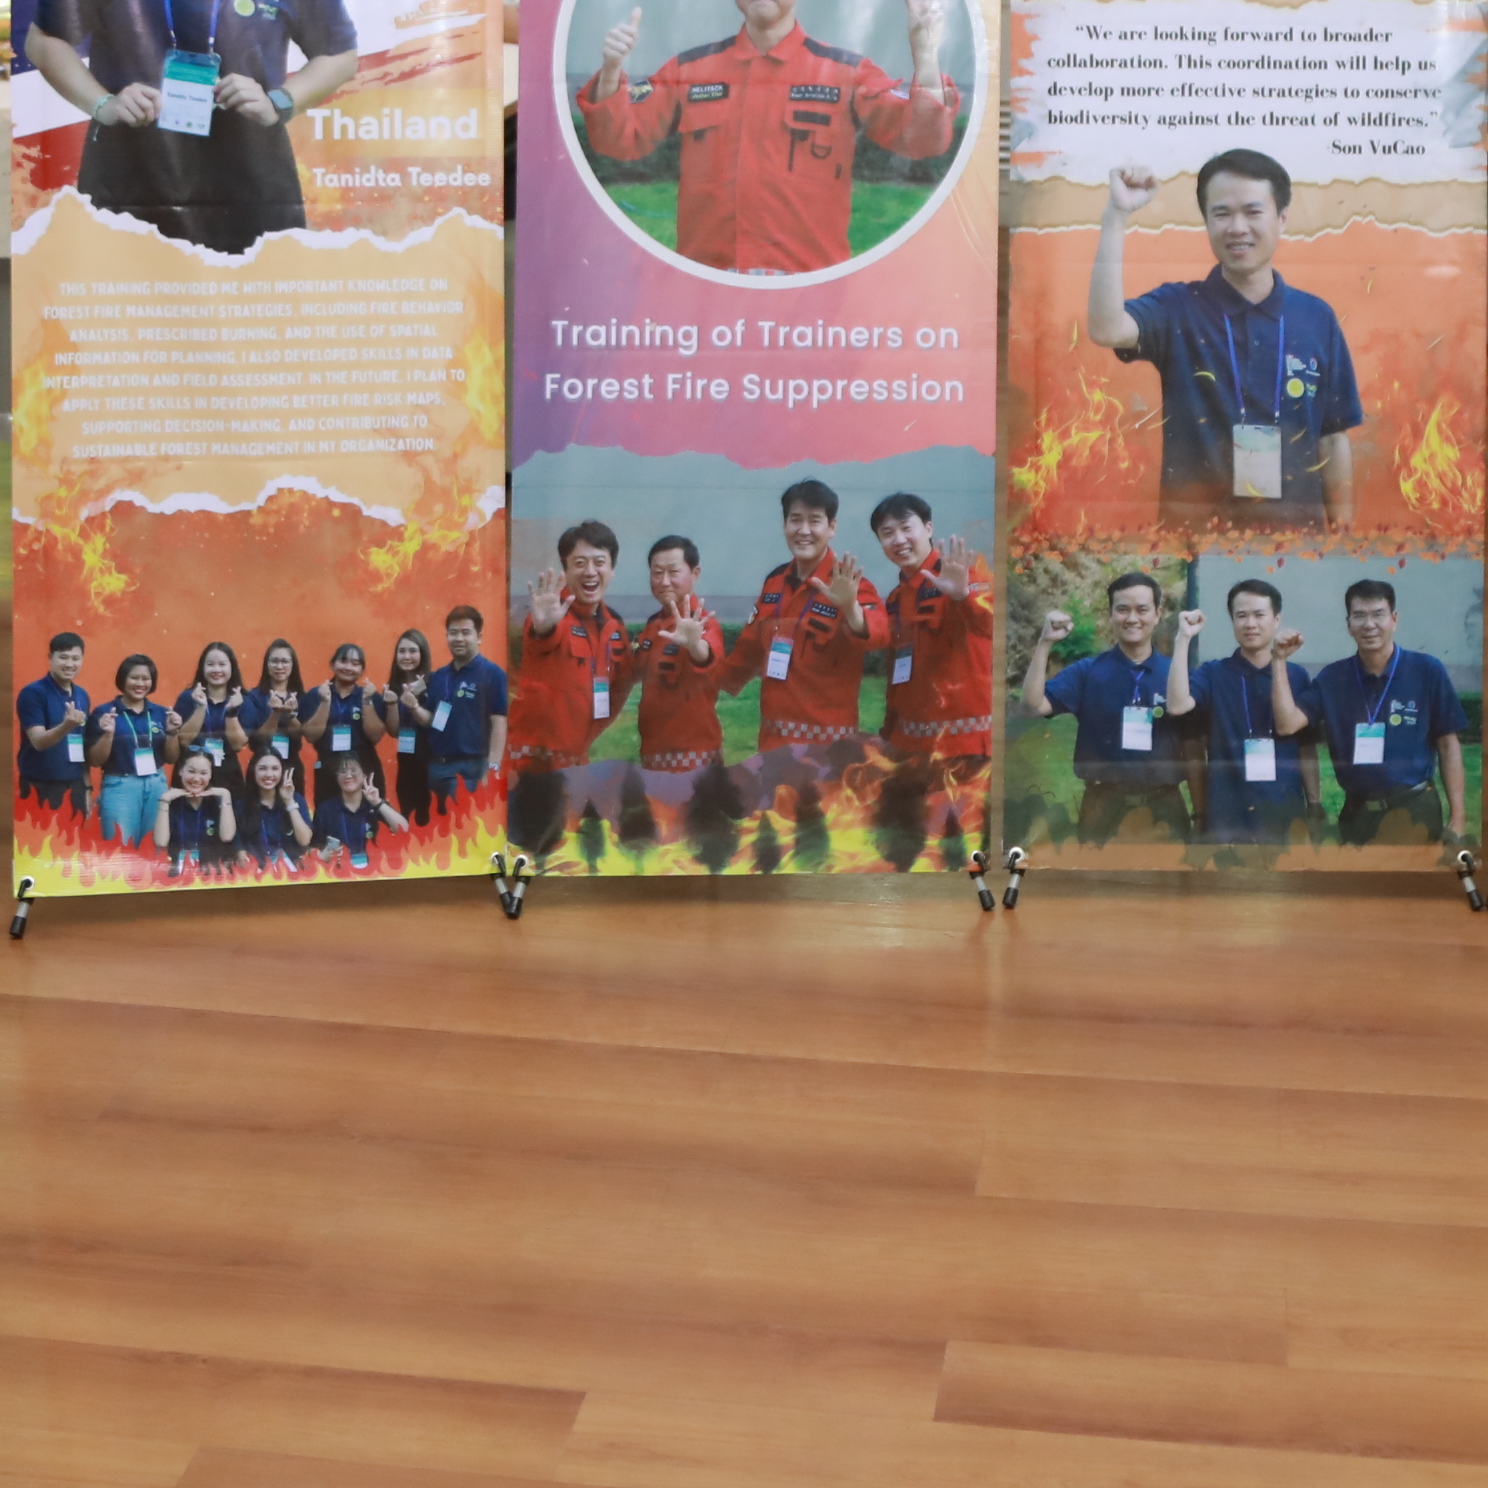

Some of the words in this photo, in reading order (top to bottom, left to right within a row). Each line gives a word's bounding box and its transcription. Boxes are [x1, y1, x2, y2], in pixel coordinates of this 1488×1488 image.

[1118, 30, 1149, 41] are
[1154, 25, 1217, 44] looking
[1223, 26, 1294, 42] forward
[1300, 30, 1317, 42] to
[1323, 27, 1393, 43] broader
[1047, 52, 1168, 69] collaboration.
[1175, 54, 1212, 69] This
[1217, 54, 1328, 71] coordination
[1335, 55, 1367, 70] will
[1373, 55, 1412, 76] help
[1418, 60, 1436, 72] us
[1047, 81, 1115, 102] develop
[1120, 86, 1165, 97] more
[1170, 82, 1246, 98] effective
[1252, 84, 1338, 102] strategies
[1343, 86, 1361, 99] to
[1365, 88, 1442, 100] conserve
[306, 107, 478, 141] Thailand
[1047, 109, 1149, 130] biodiversity
[1156, 111, 1219, 129] against
[1227, 111, 1255, 126] the
[1261, 111, 1316, 127] threat
[1322, 112, 1339, 127] of
[1369, 139, 1426, 155] VuCao
[313, 166, 402, 188] Tanidta
[408, 165, 492, 188] Teedee
[60, 282, 87, 296] THIS
[91, 281, 151, 296] TRAINING
[154, 280, 219, 296] PROVIDED
[220, 281, 239, 295] ME
[242, 281, 272, 295] WITH
[274, 279, 344, 293] IMPORTANT
[347, 277, 426, 293] KNOWLEDGE
[429, 278, 448, 291] ON
[551, 317, 698, 355] Training
[711, 318, 746, 347] of
[757, 319, 903, 348] Trainers
[915, 326, 959, 349] on
[545, 373, 654, 401] Forest
[666, 370, 730, 401] Fire
[742, 372, 964, 410] Suppression
[72, 442, 157, 458] SUSTAINABLE
[160, 441, 208, 456] FOREST
[210, 441, 300, 456] MANAGEMENT
[302, 440, 316, 454] IN
[318, 440, 336, 453] MY
